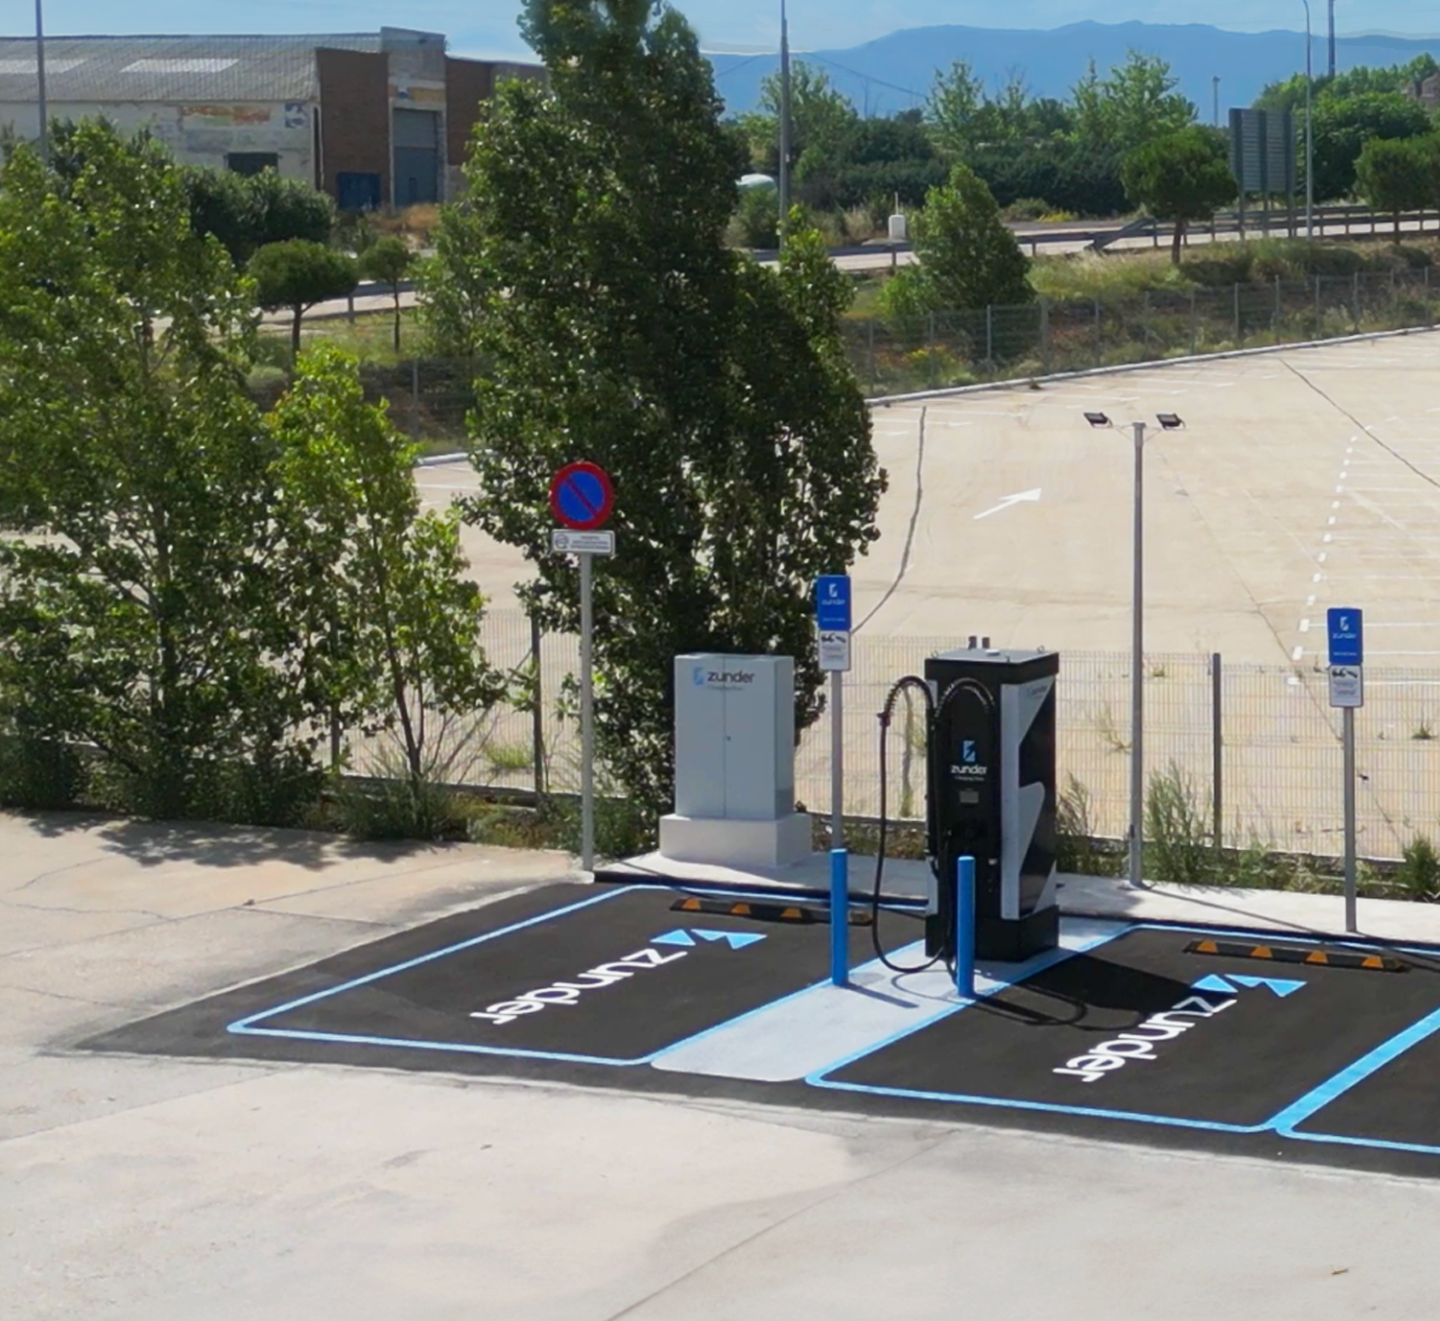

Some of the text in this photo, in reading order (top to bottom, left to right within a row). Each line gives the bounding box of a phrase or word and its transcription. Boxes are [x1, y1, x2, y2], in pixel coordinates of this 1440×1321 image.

[707, 670, 755, 684] zunder
[950, 764, 988, 775] zunder
[469, 948, 688, 1025] zunder
[1052, 996, 1238, 1082] zunder
